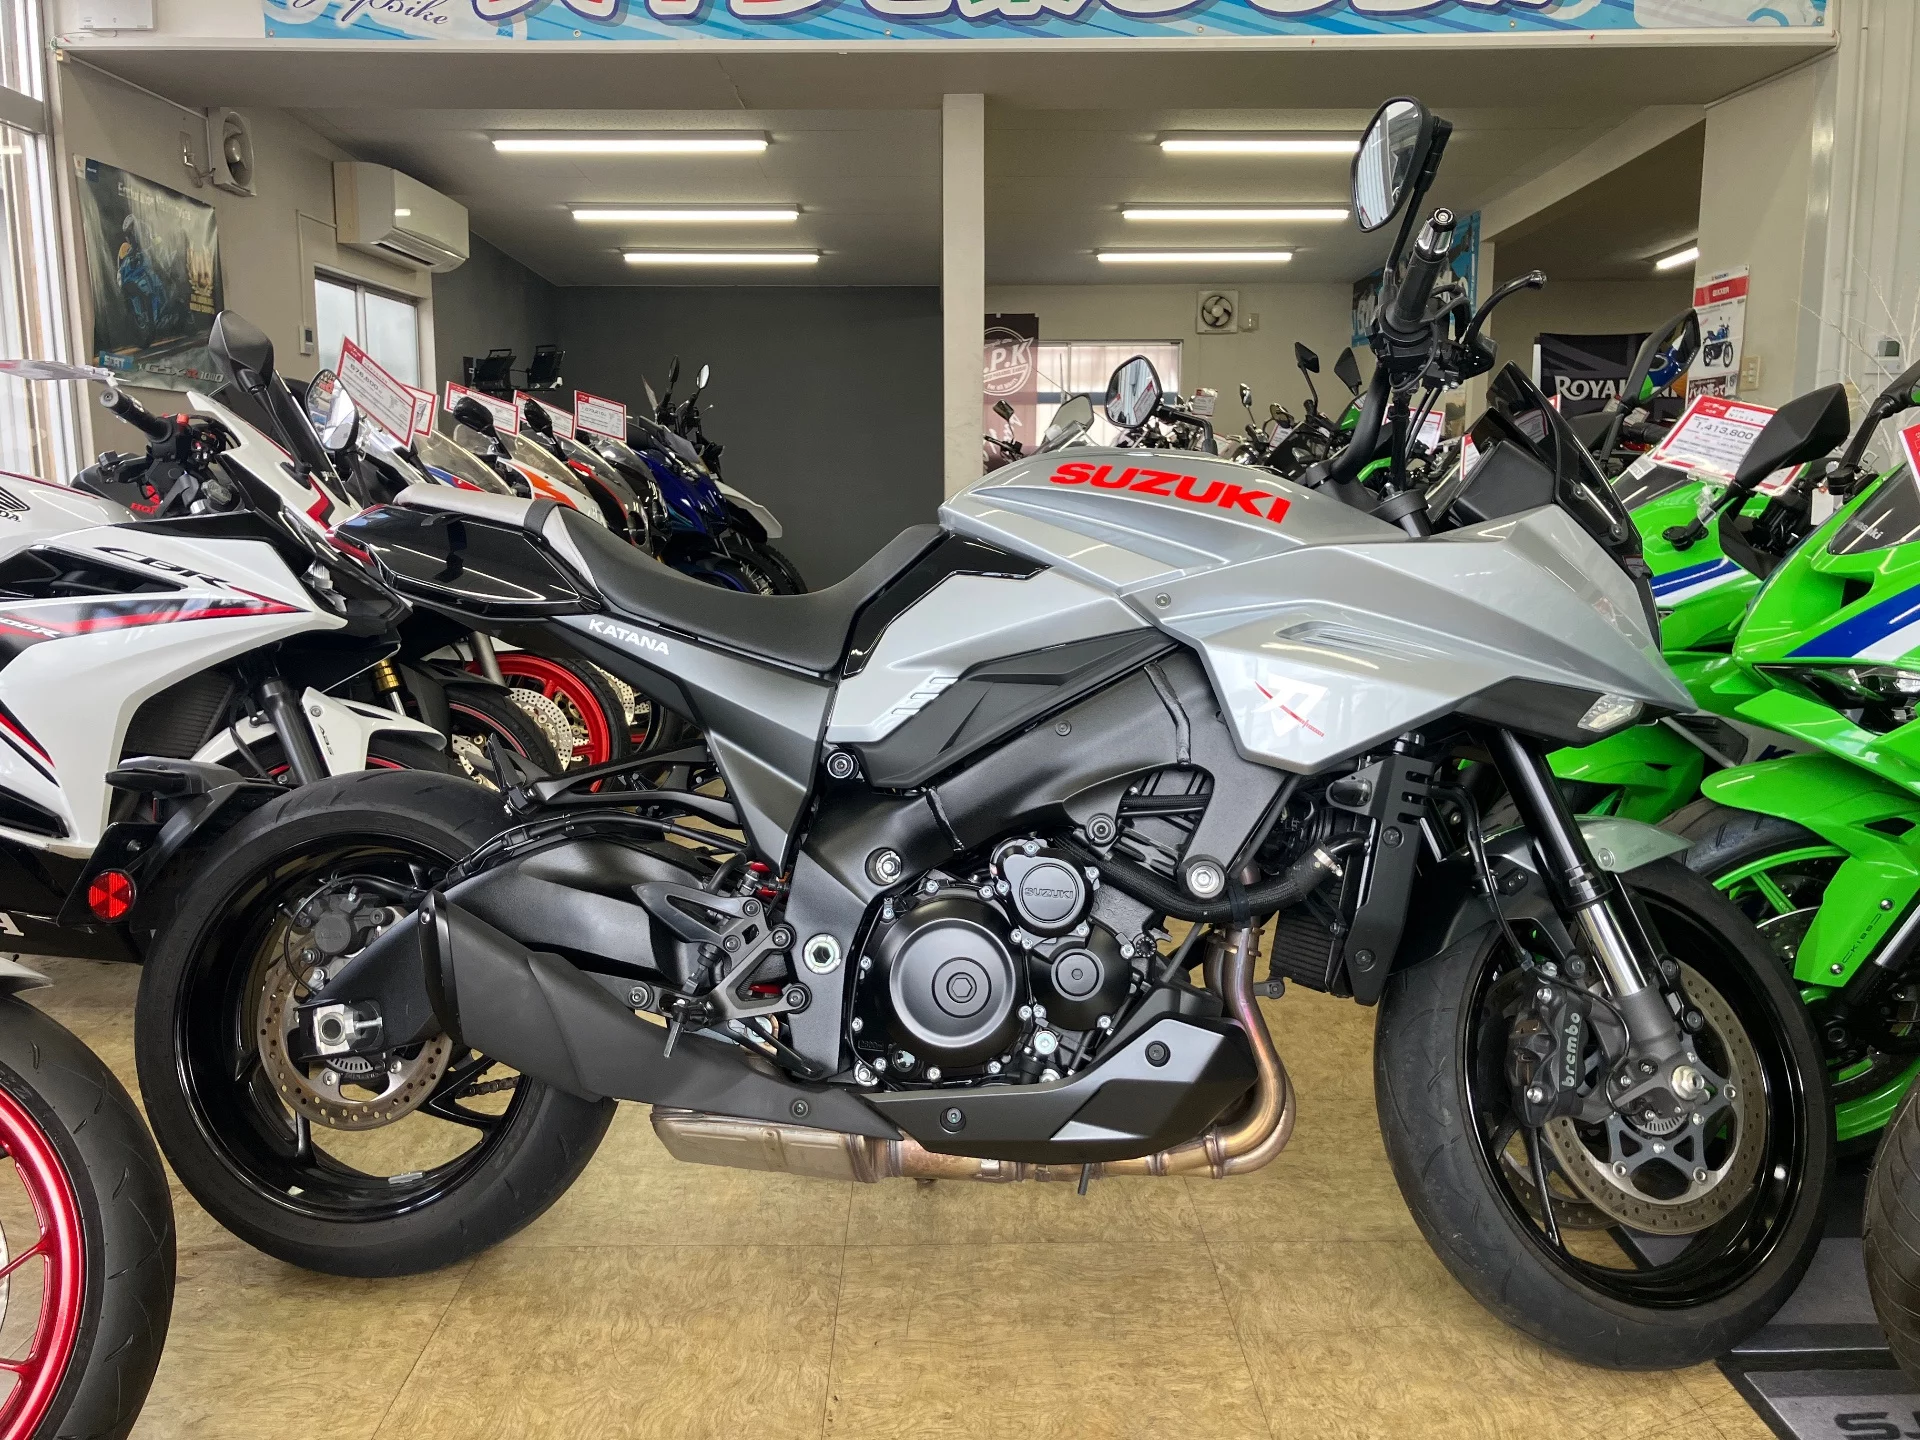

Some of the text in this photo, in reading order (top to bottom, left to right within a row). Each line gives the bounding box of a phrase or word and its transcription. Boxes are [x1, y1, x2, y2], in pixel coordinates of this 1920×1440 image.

[1050, 463, 1291, 524] SUZUKI
[94, 547, 230, 590] CBR
[588, 618, 670, 656] KATANA
[1024, 887, 1074, 900] SUZUKI
[1561, 1012, 1581, 1087] brembo
